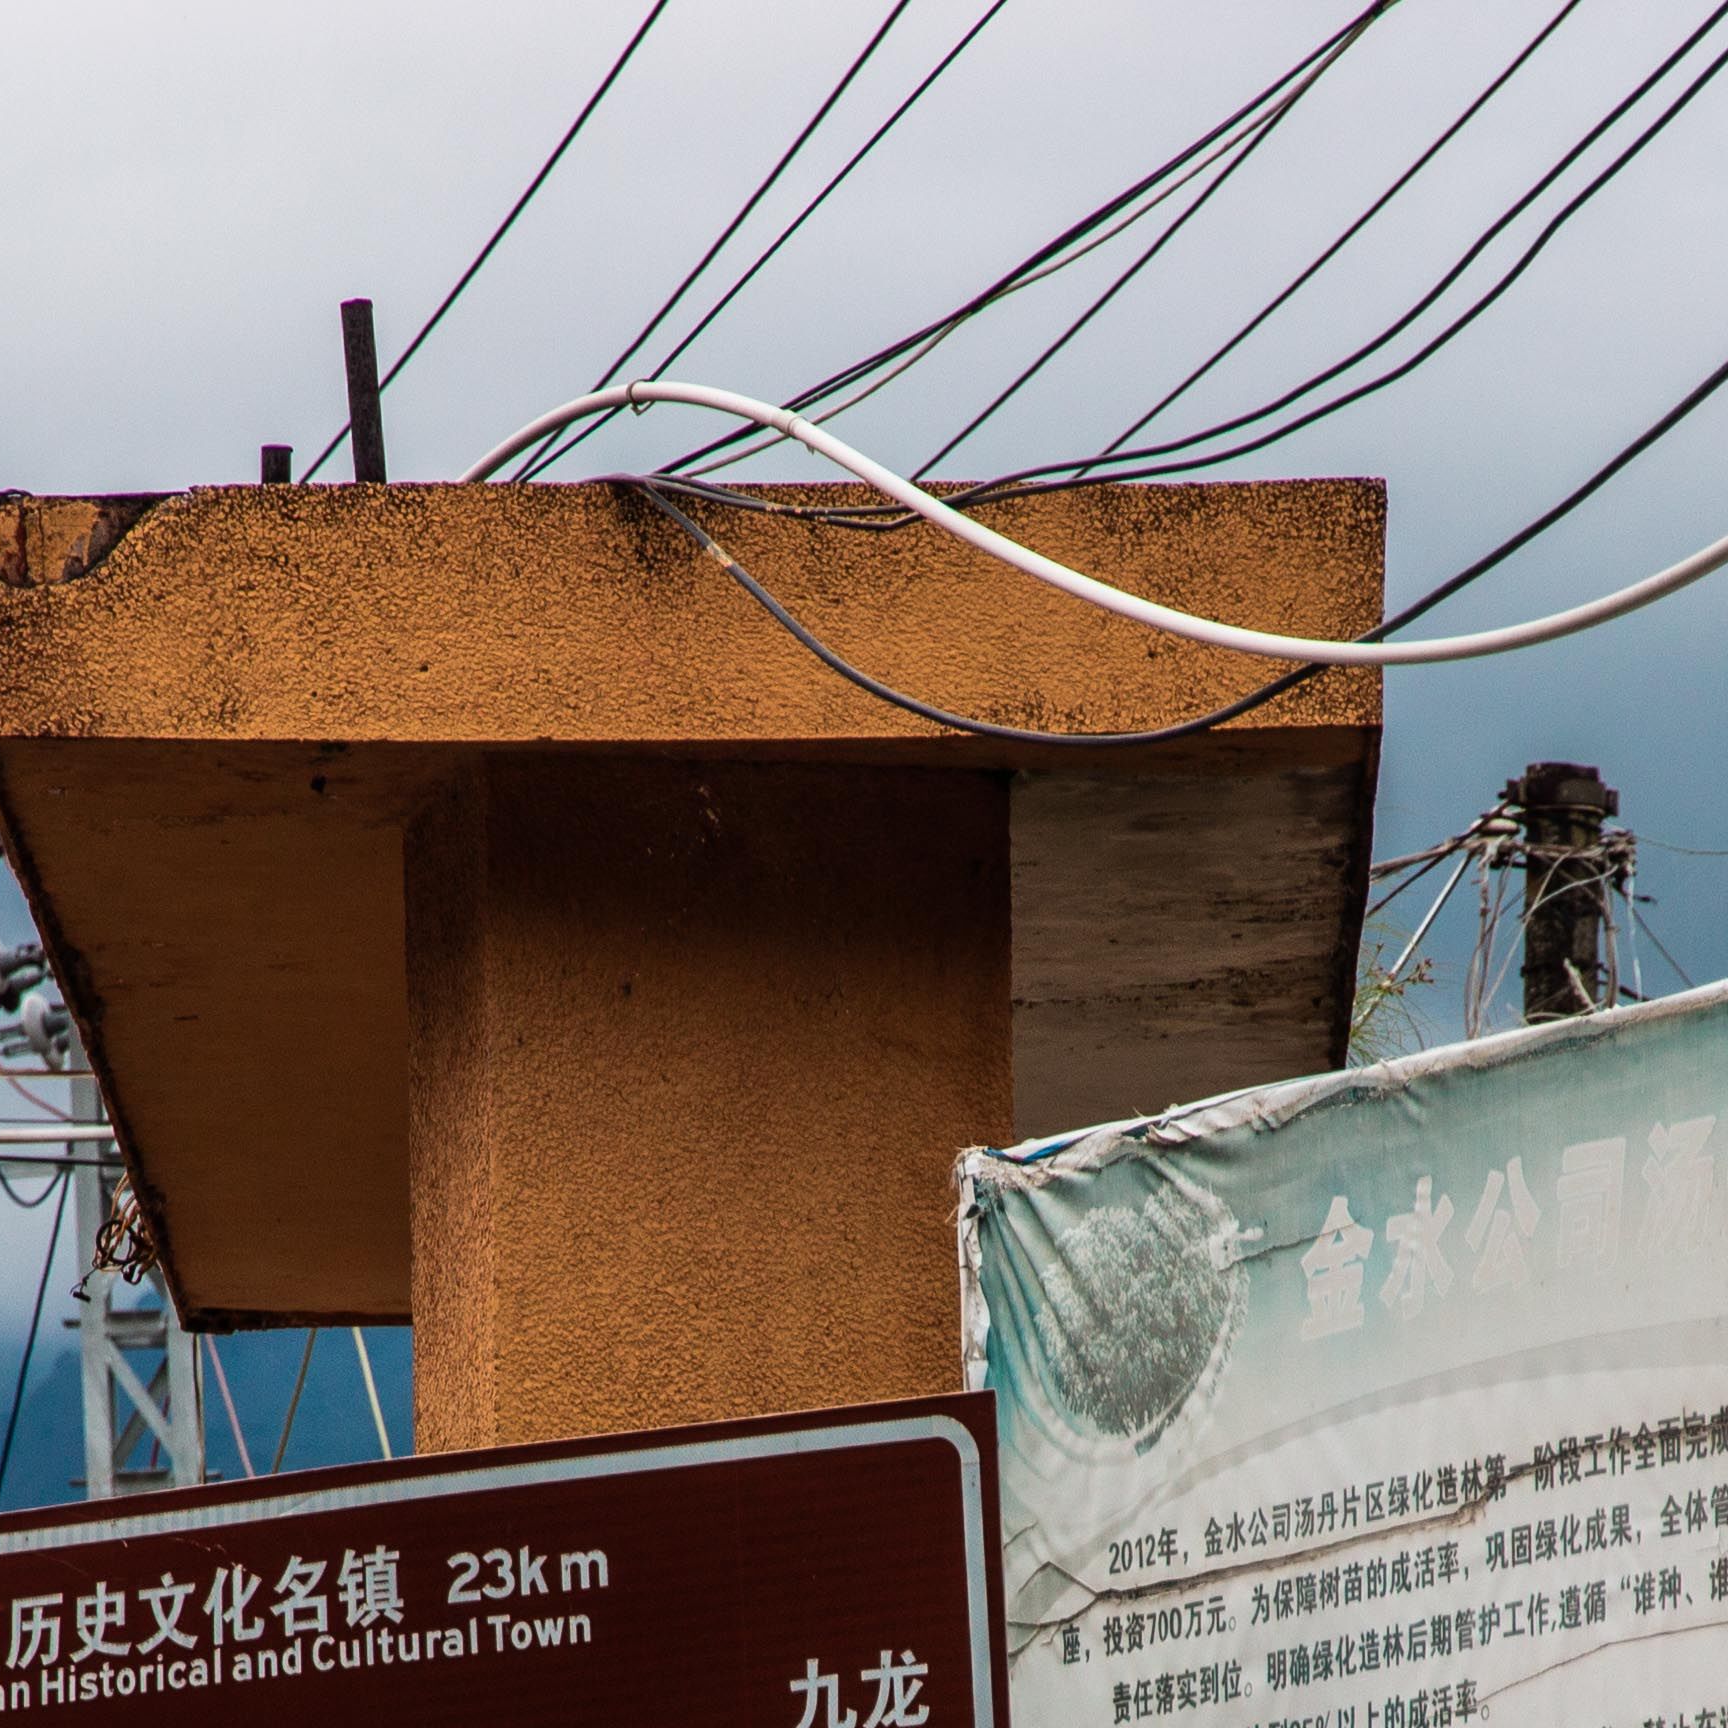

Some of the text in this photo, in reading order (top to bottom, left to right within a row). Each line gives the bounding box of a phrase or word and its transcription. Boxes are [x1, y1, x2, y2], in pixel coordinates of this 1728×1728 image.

[448, 1546, 608, 1603] 23km
[42, 1648, 221, 1705] Historical
[233, 1638, 301, 1681] and
[313, 1618, 478, 1670] Cultural
[488, 1615, 590, 1651] Town
